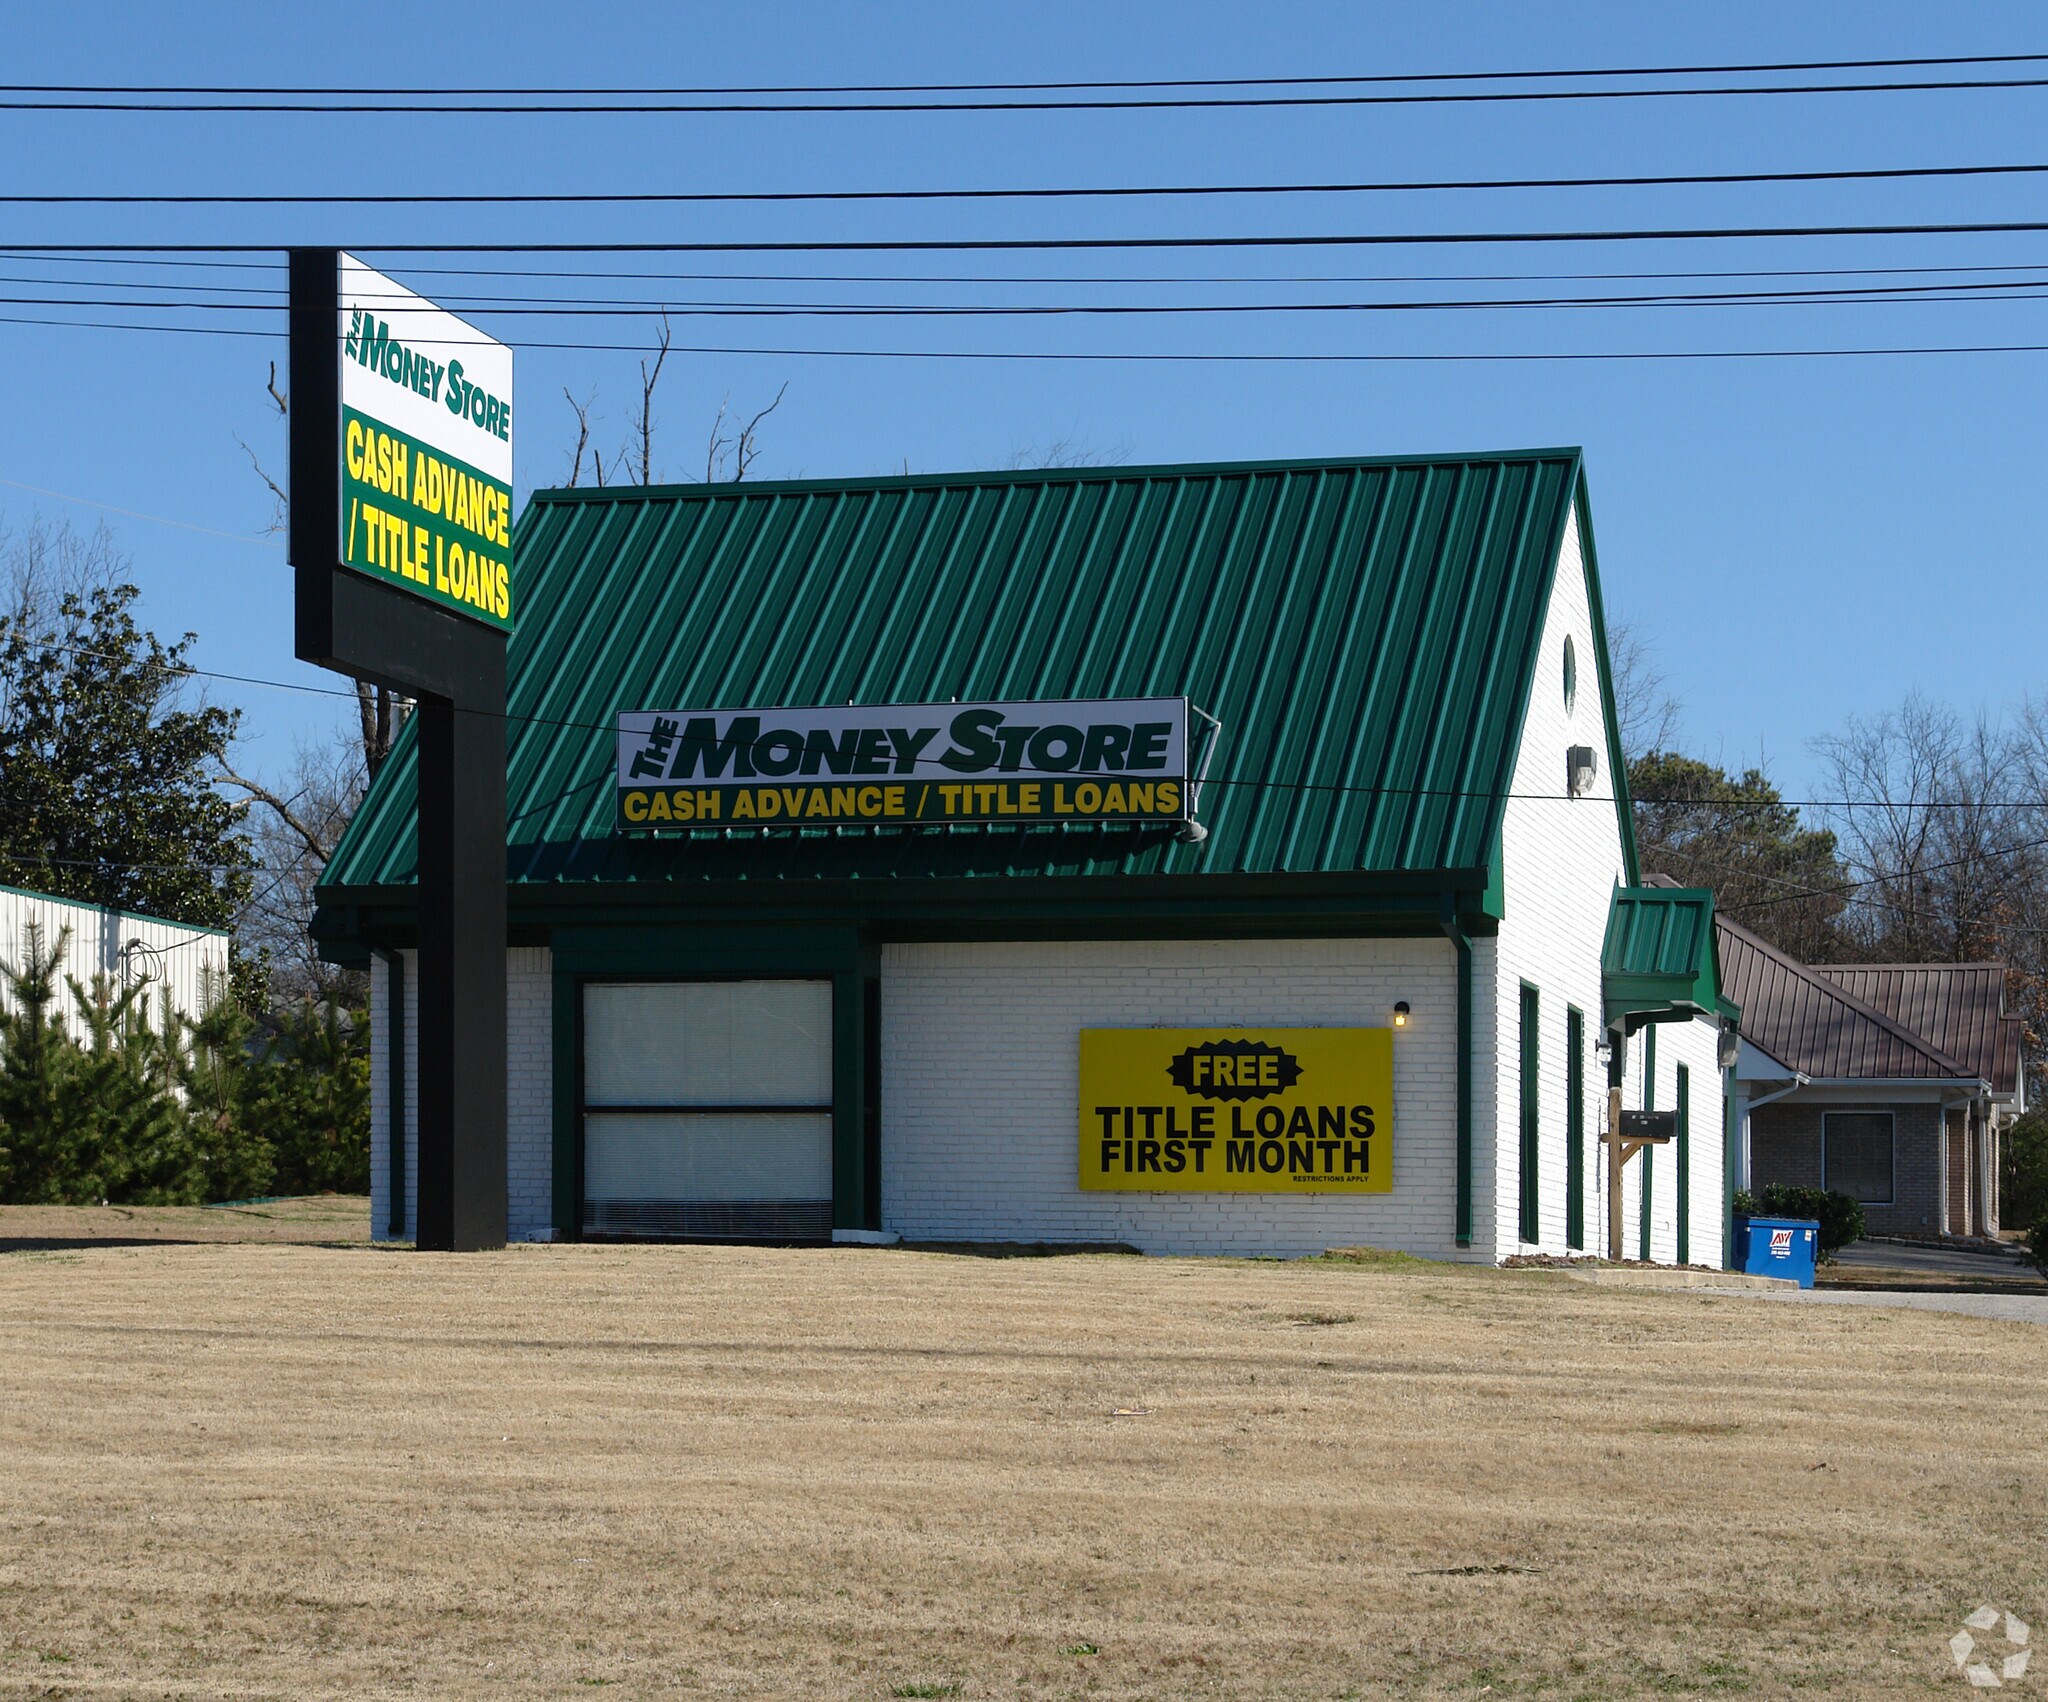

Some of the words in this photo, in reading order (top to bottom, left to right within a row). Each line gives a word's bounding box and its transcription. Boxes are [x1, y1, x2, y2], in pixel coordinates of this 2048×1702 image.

[345, 303, 362, 361] THE
[358, 312, 445, 403] MONEY
[445, 359, 511, 442] STORE
[346, 419, 408, 502] CASH
[412, 451, 509, 548] ADVANCE
[362, 502, 430, 586] TITLE
[435, 534, 510, 619] LOANS
[628, 716, 680, 779] THE
[668, 716, 942, 779] MONEY
[939, 708, 1173, 773] STORE
[624, 790, 721, 822] CASH
[731, 786, 906, 819] ADVANCE
[938, 784, 1041, 815] TITLE
[1053, 782, 1180, 814] LOANS
[1192, 1055, 1279, 1087] FREE
[1095, 1106, 1216, 1139] TITLE
[1231, 1105, 1375, 1139] LOANS
[1101, 1139, 1212, 1173] FIRST
[1226, 1139, 1370, 1173] MONTH
[1293, 1175, 1345, 1183] RESTRICTIONS
[1346, 1175, 1369, 1183] APPLY
